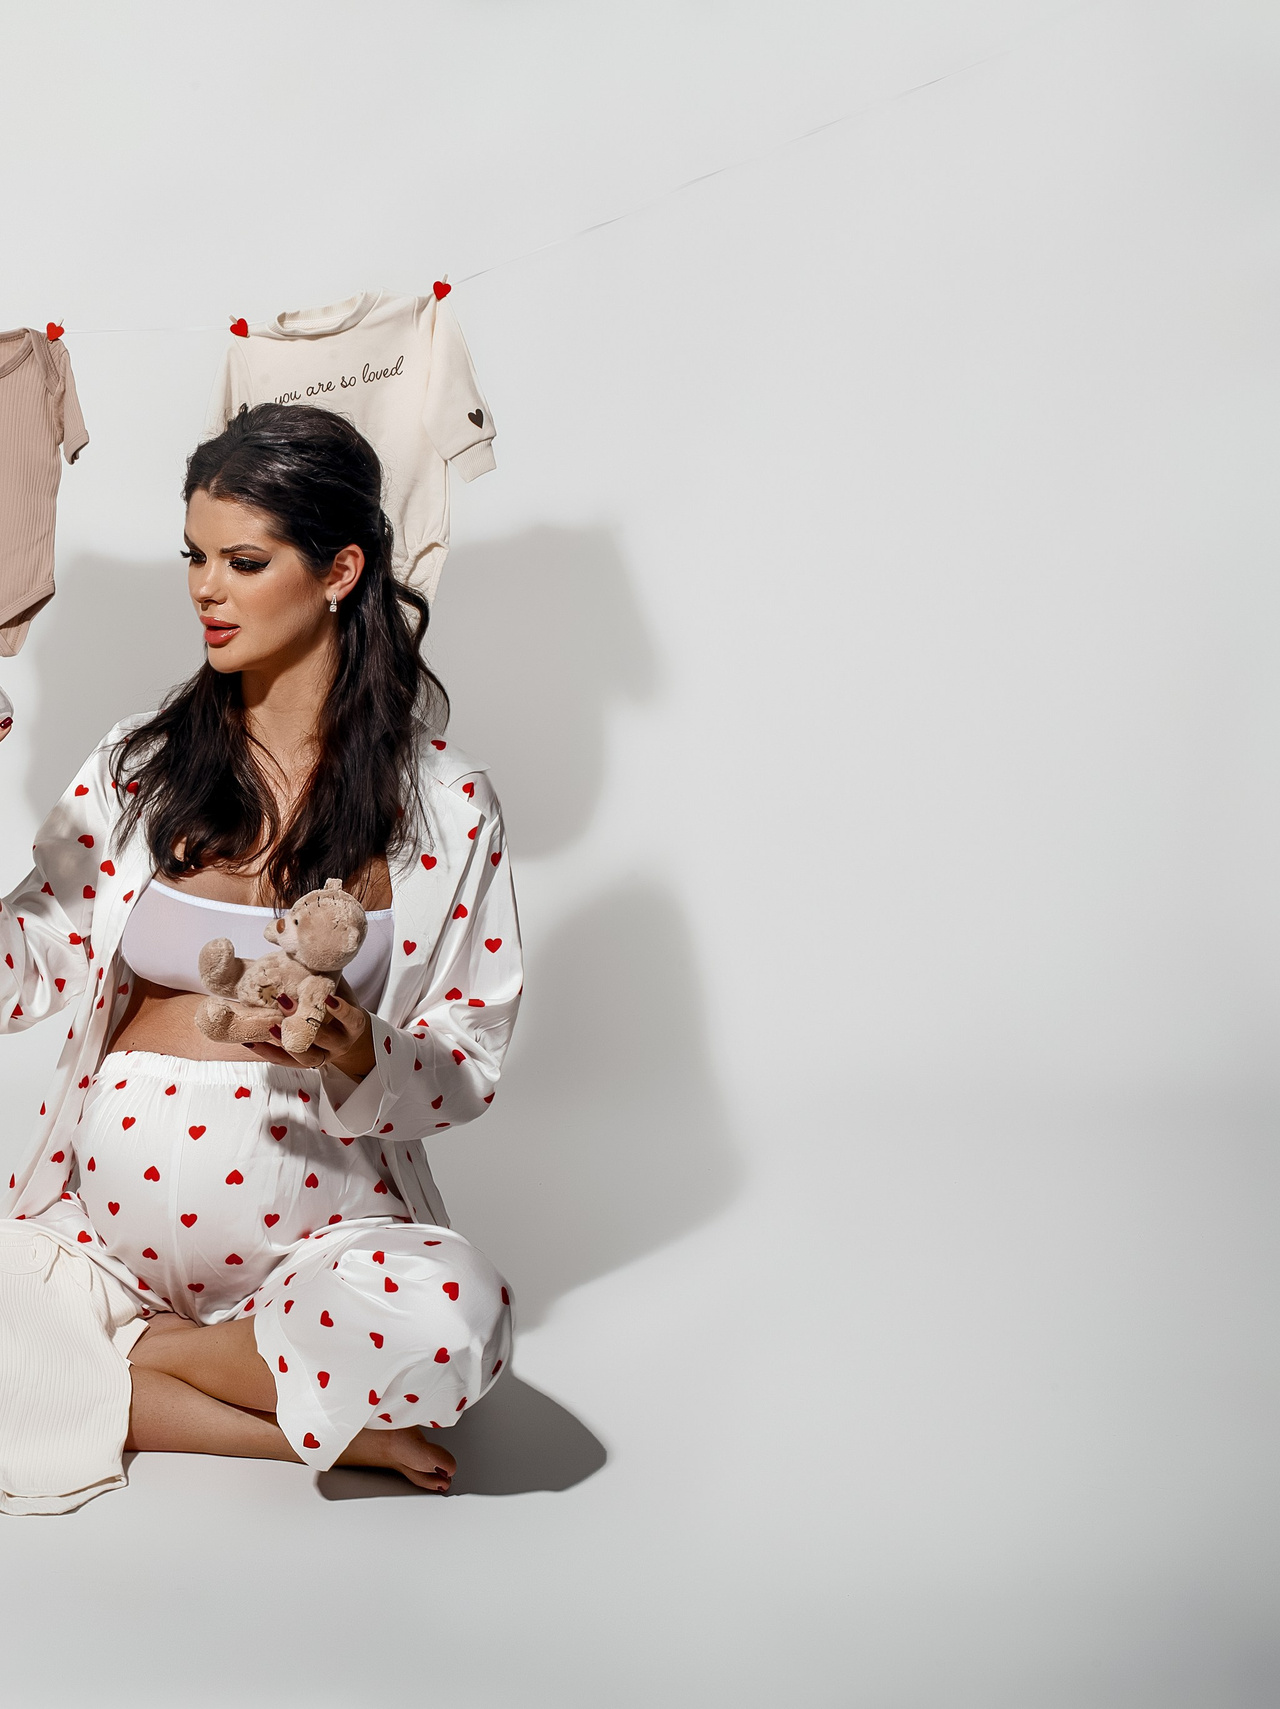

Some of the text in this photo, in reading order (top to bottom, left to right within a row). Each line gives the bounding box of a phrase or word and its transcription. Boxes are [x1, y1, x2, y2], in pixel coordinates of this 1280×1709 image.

[306, 381, 335, 397] are
[340, 374, 357, 388] so
[362, 355, 404, 383] loved
